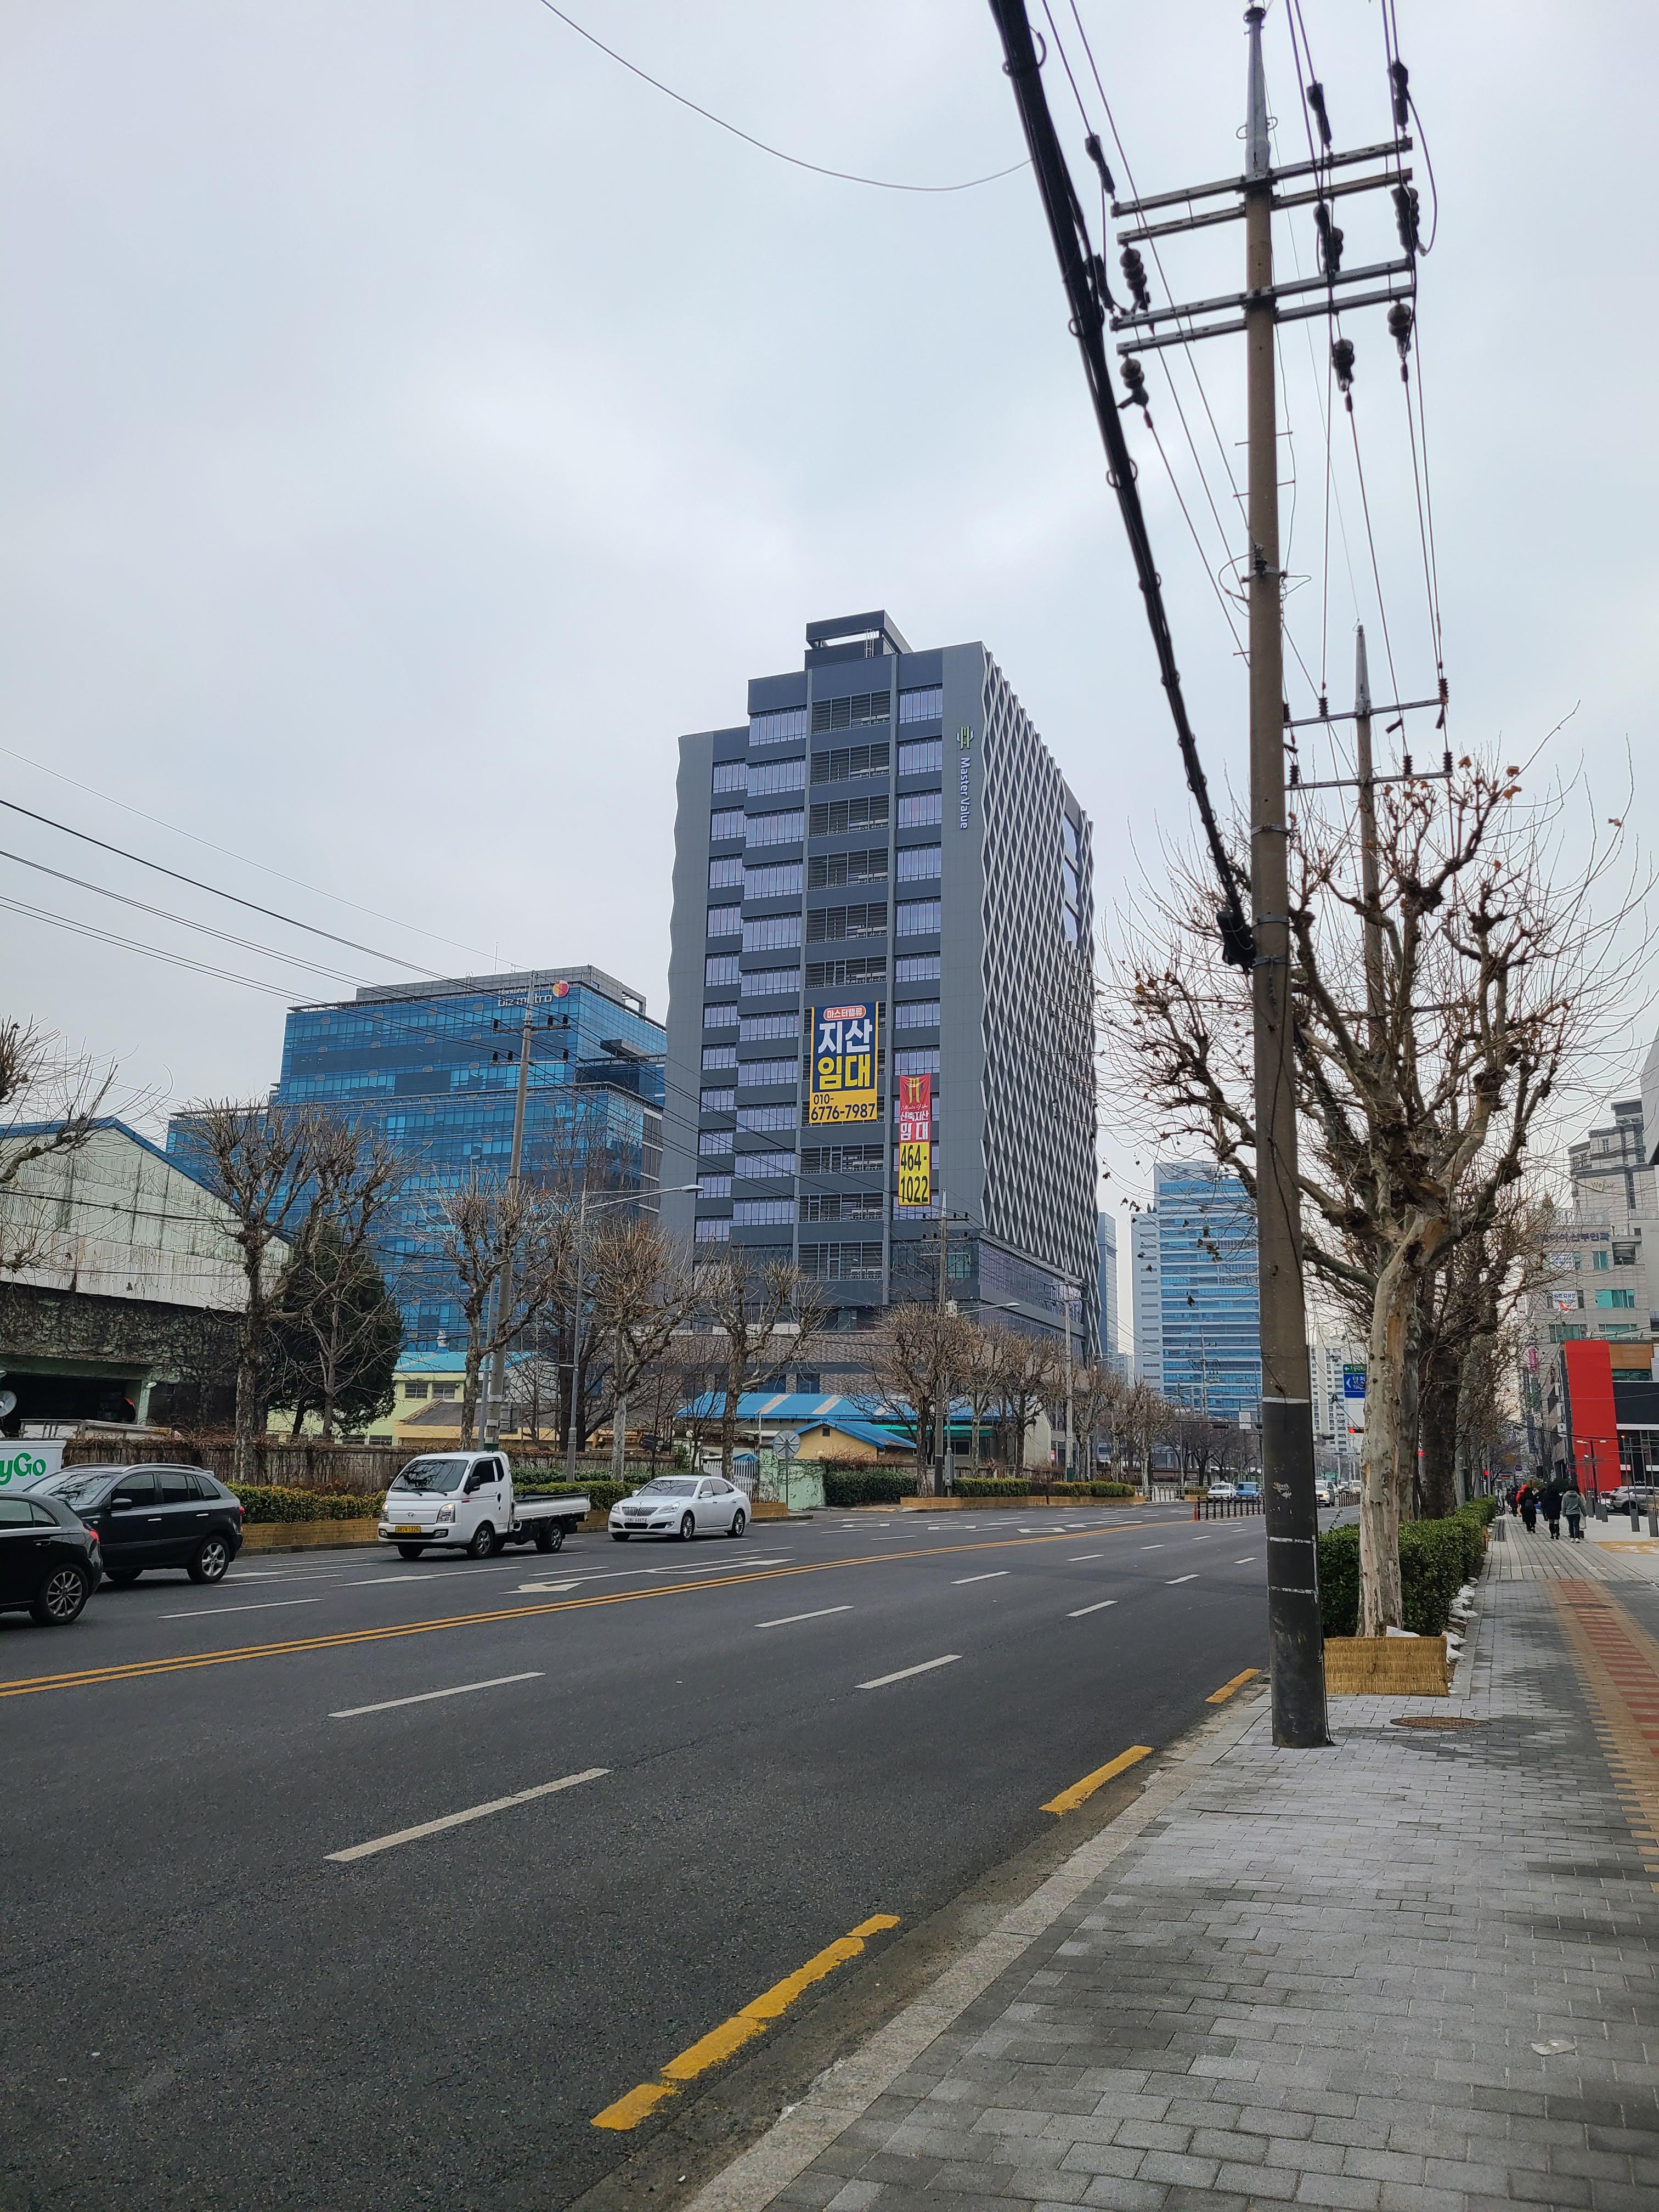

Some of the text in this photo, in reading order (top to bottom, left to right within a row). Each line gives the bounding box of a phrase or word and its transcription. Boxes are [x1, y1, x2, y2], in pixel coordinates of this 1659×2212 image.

[960, 757, 970, 830] Master Value
[827, 1008, 862, 1019] 마스터밸류
[818, 1019, 873, 1054] 지산
[817, 1053, 871, 1090] 임대
[811, 1103, 876, 1121] 6776-7987
[814, 1093, 834, 1105] 010-
[900, 1110, 929, 1121] 신축지산
[900, 1144, 927, 1171] 464-
[900, 1175, 928, 1203] 1022
